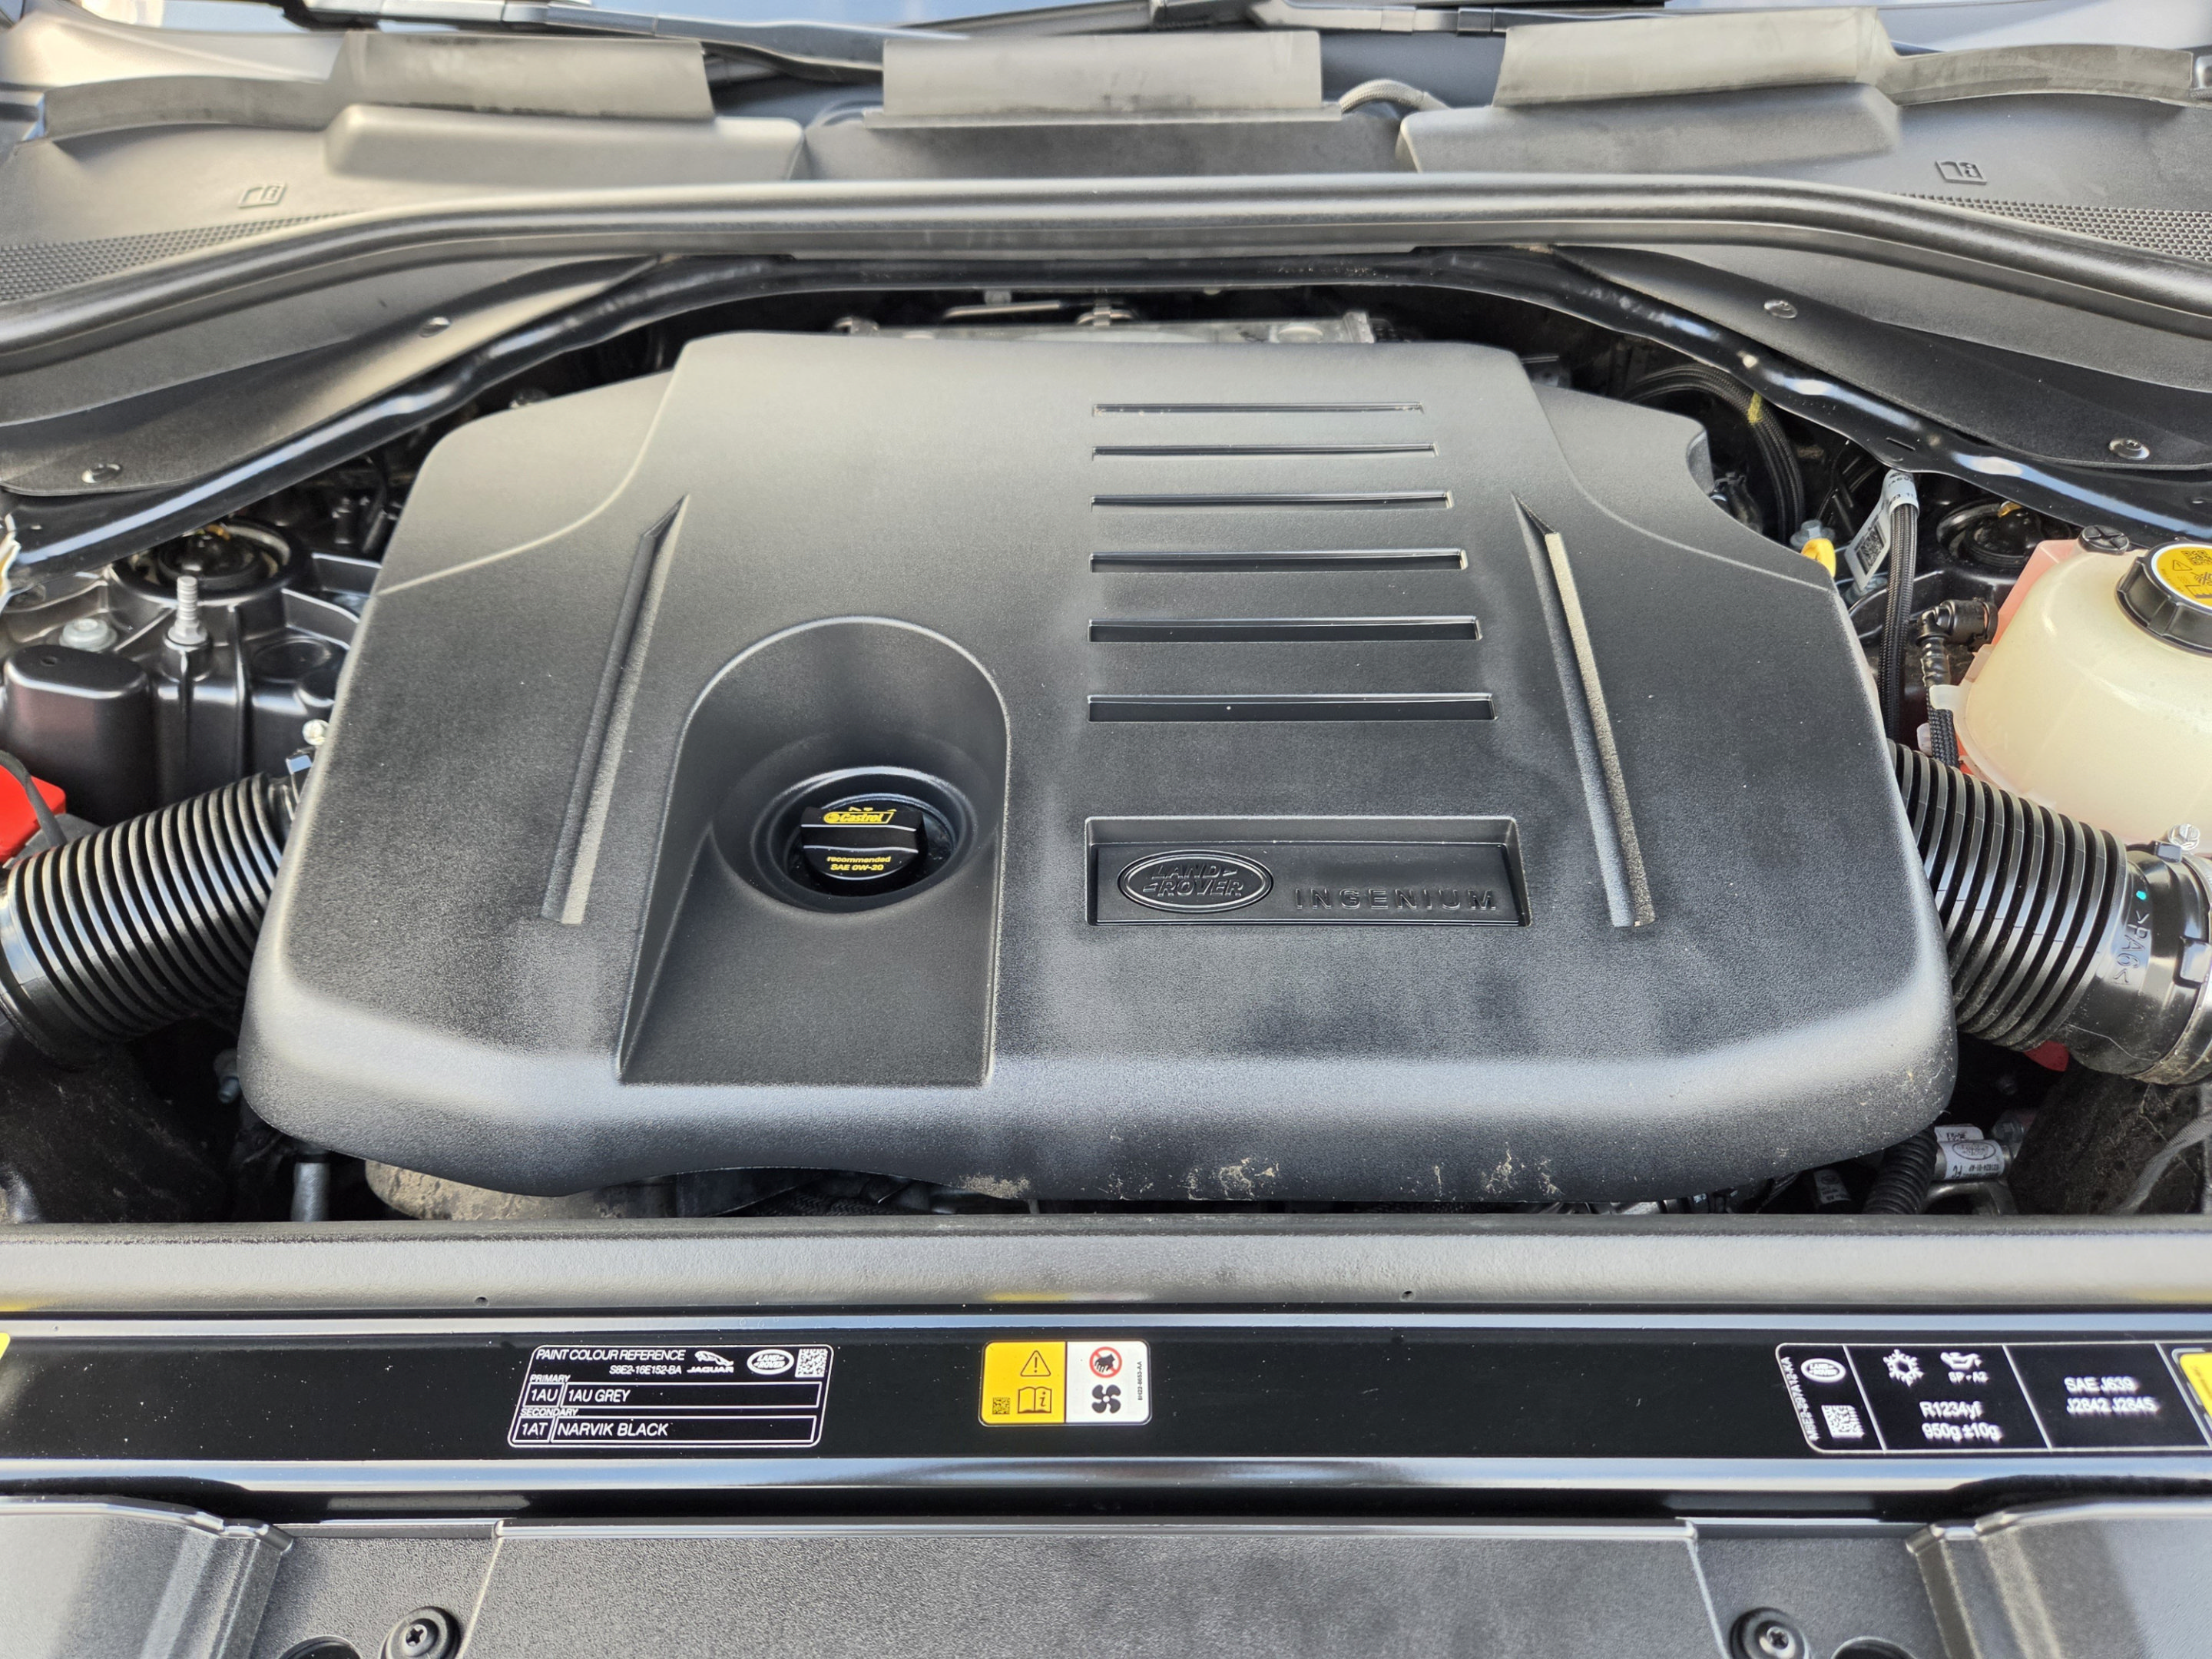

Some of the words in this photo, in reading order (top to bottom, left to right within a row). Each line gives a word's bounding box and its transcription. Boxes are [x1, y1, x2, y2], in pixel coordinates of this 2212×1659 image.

[839, 813, 884, 823] Castrol
[1151, 864, 1221, 879] LAND
[1157, 879, 1244, 896] ROVER
[1294, 888, 1497, 912] INGENIUM
[536, 1349, 569, 1360] PAINT
[569, 1349, 619, 1360] COLOUR
[619, 1349, 686, 1360] REFERENCE
[529, 1374, 571, 1382] PRIMARY
[2064, 1376, 2101, 1392] SAE
[531, 1389, 558, 1402] 1AU
[568, 1389, 593, 1402] 1AU
[594, 1389, 631, 1402] GREY
[522, 1422, 548, 1435] 1AT
[557, 1422, 614, 1435] NARVIK
[617, 1422, 668, 1436] BLACK
[1922, 1422, 1963, 1442] 950g
